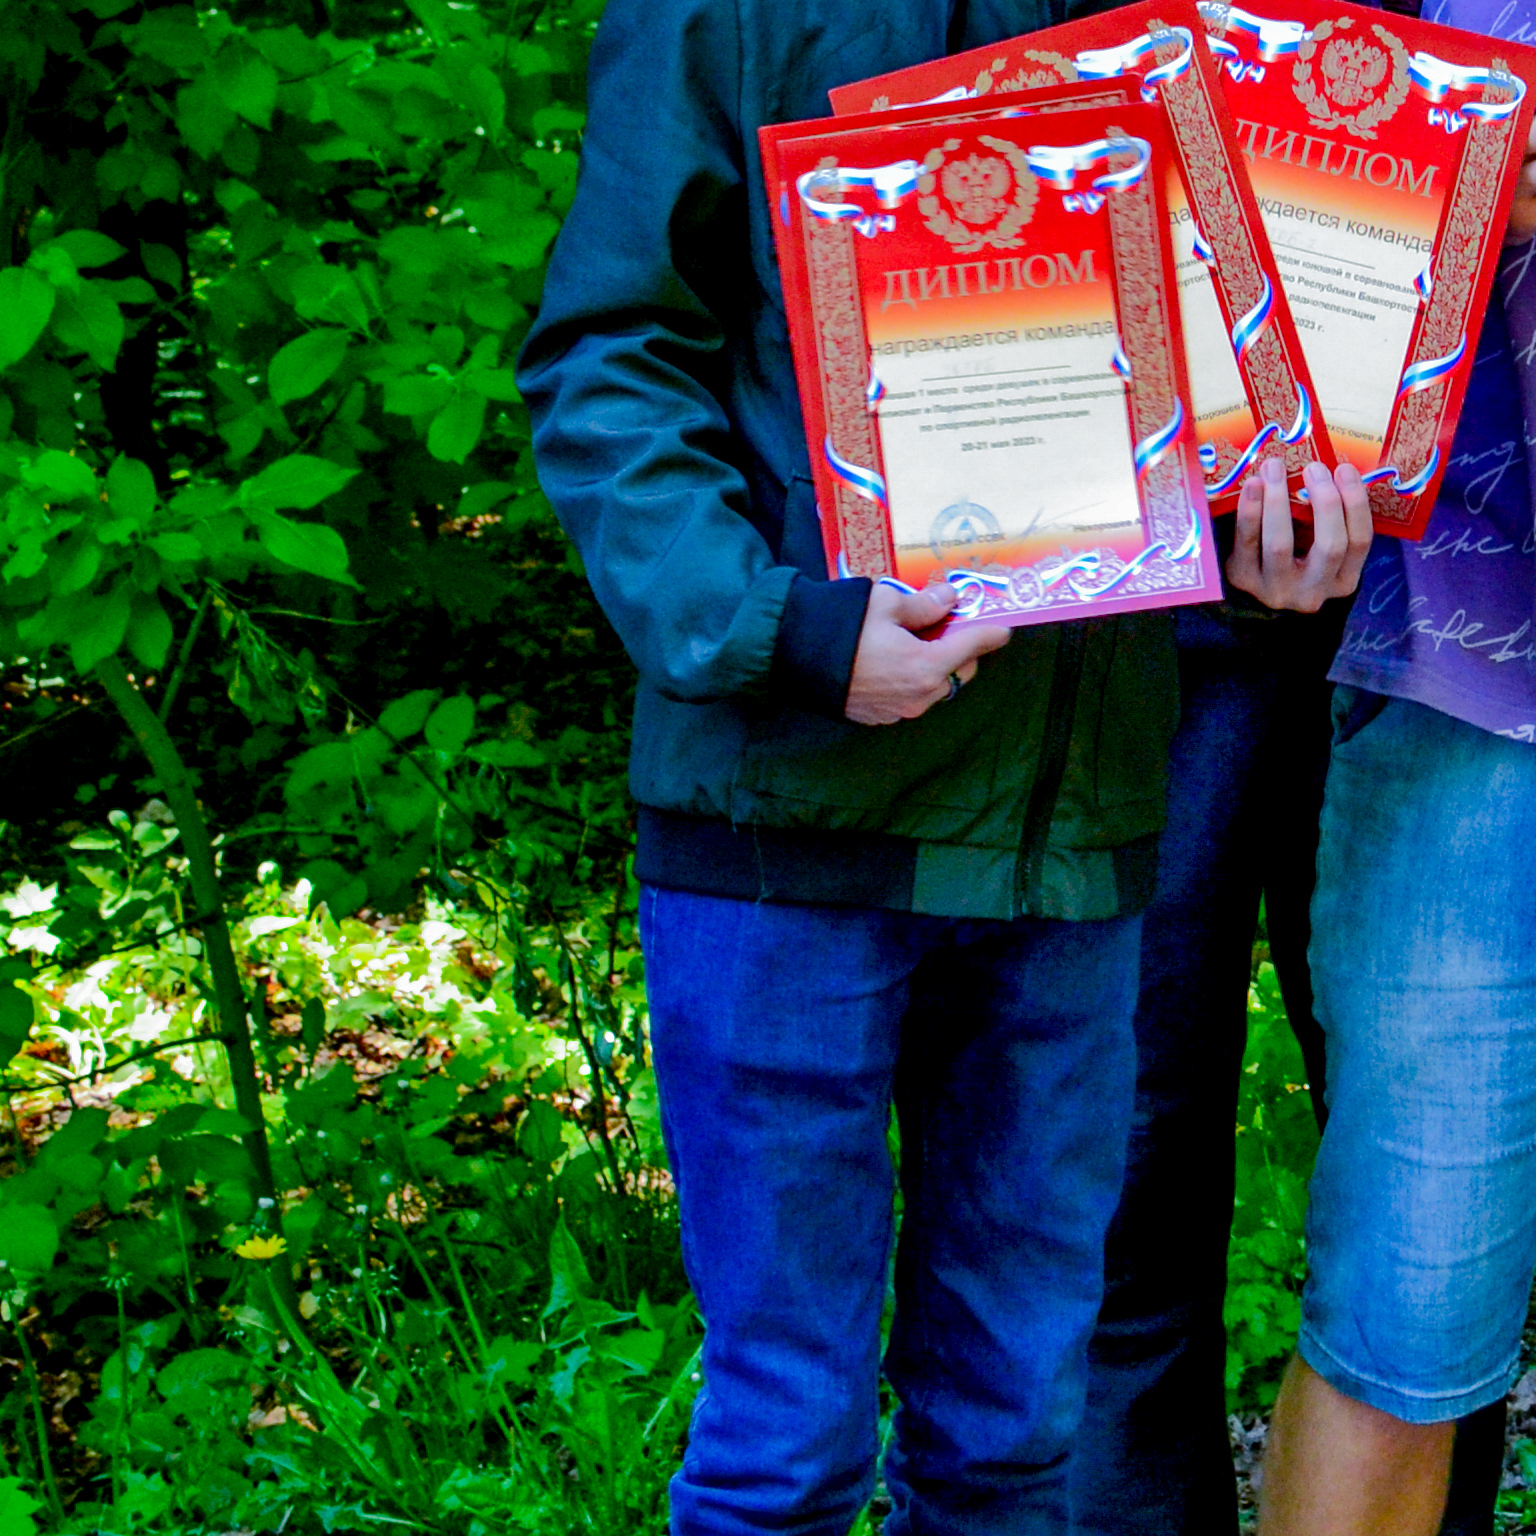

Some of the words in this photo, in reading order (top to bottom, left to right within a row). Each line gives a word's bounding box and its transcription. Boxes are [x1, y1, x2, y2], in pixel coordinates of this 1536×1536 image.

[1236, 117, 1440, 198] ДИПЛОМ
[1345, 218, 1433, 254] команда
[881, 249, 1099, 313] ДИПЛОМ
[1298, 275, 1356, 298] Республики
[1302, 259, 1343, 278] юношей
[871, 328, 1018, 357] награждается
[1025, 319, 1116, 343] команда
